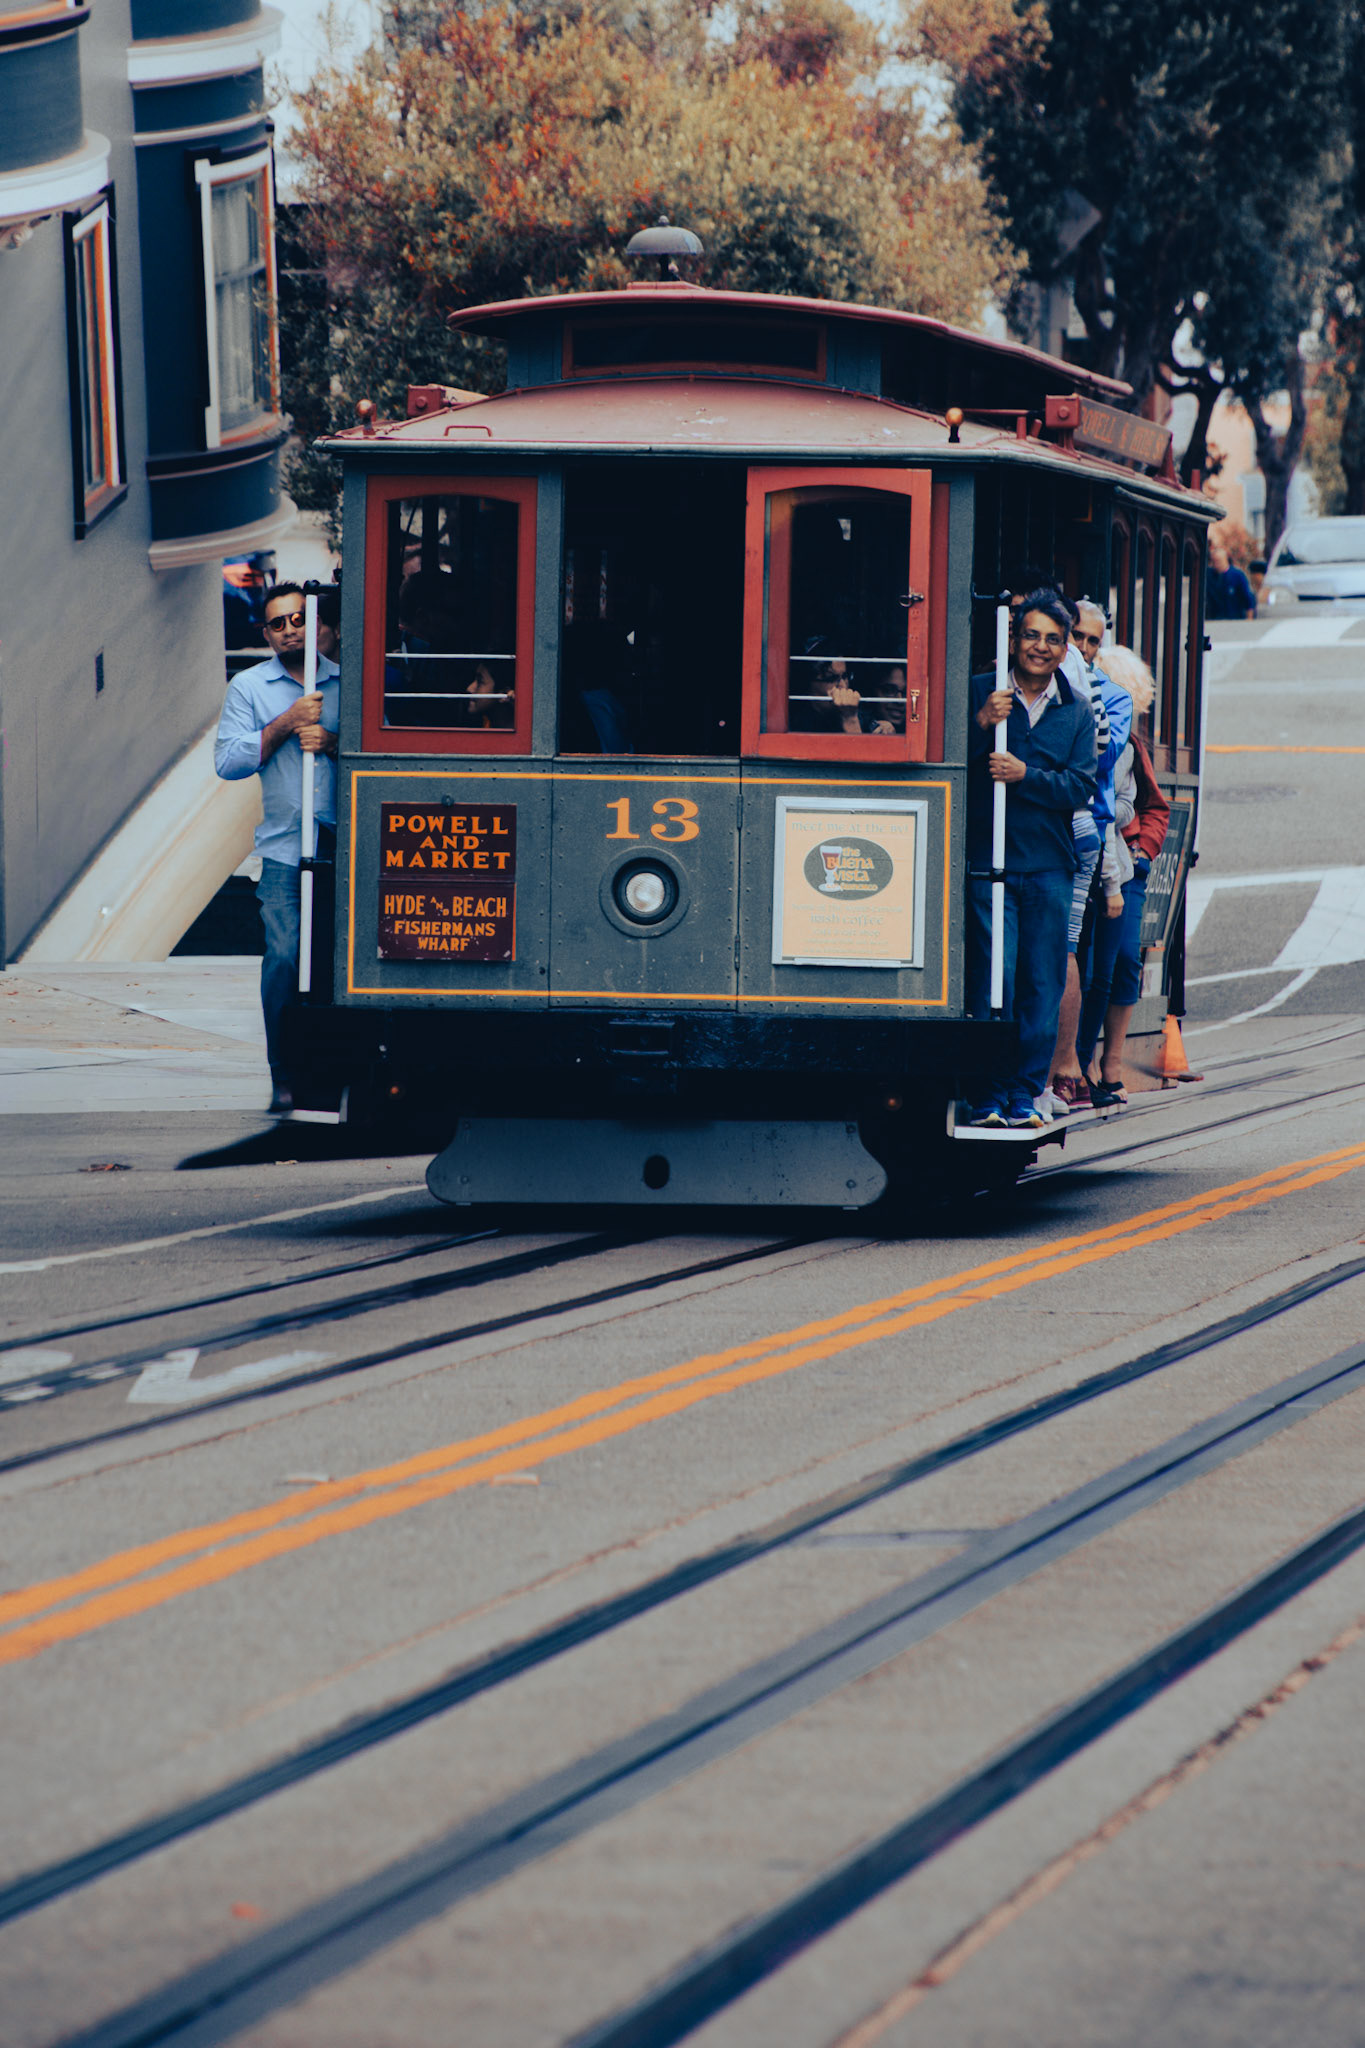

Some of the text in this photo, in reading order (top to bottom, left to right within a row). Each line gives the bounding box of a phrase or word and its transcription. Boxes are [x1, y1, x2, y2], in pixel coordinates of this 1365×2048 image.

[389, 815, 509, 835] POWELL
[606, 797, 700, 842] 13
[420, 835, 480, 850] AND
[386, 850, 511, 870] MARKET
[384, 895, 507, 918] HYDE AND BEACH
[394, 920, 496, 937] FISHERMANS
[418, 937, 471, 951] WHARF
